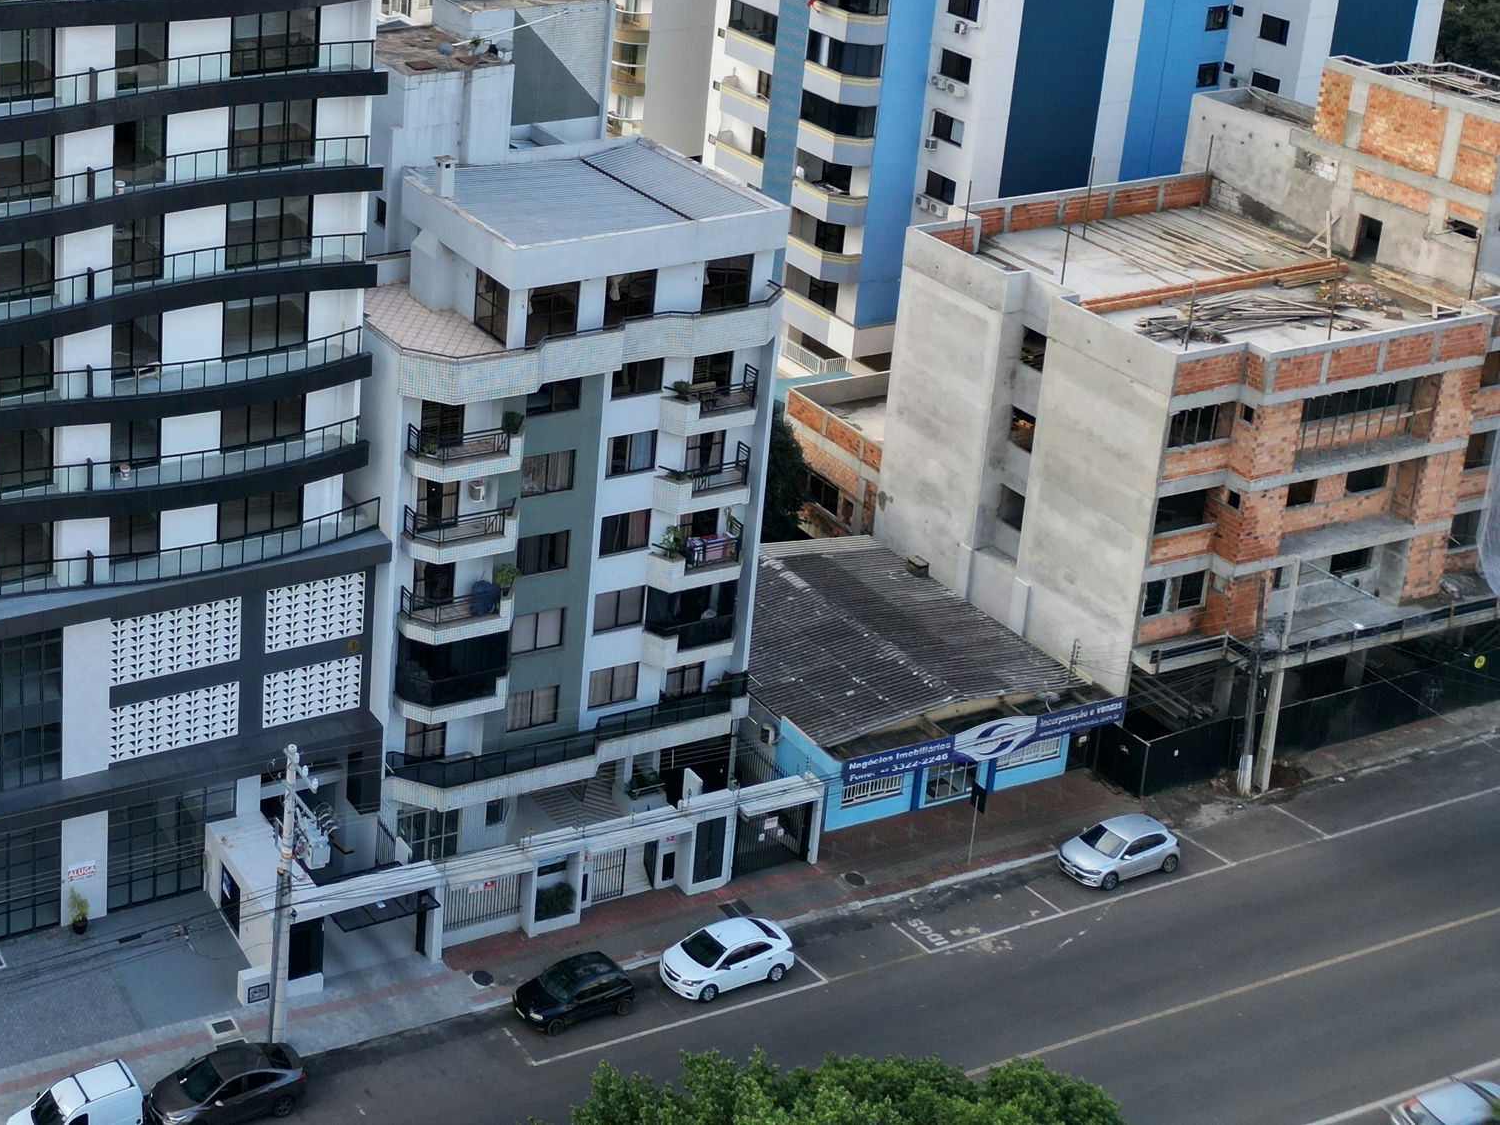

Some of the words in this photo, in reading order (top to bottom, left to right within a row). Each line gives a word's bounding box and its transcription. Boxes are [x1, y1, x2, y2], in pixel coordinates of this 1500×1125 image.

[849, 755, 893, 770] Negócios
[896, 742, 951, 760] Imobiliários
[69, 866, 95, 877] ALUGA
